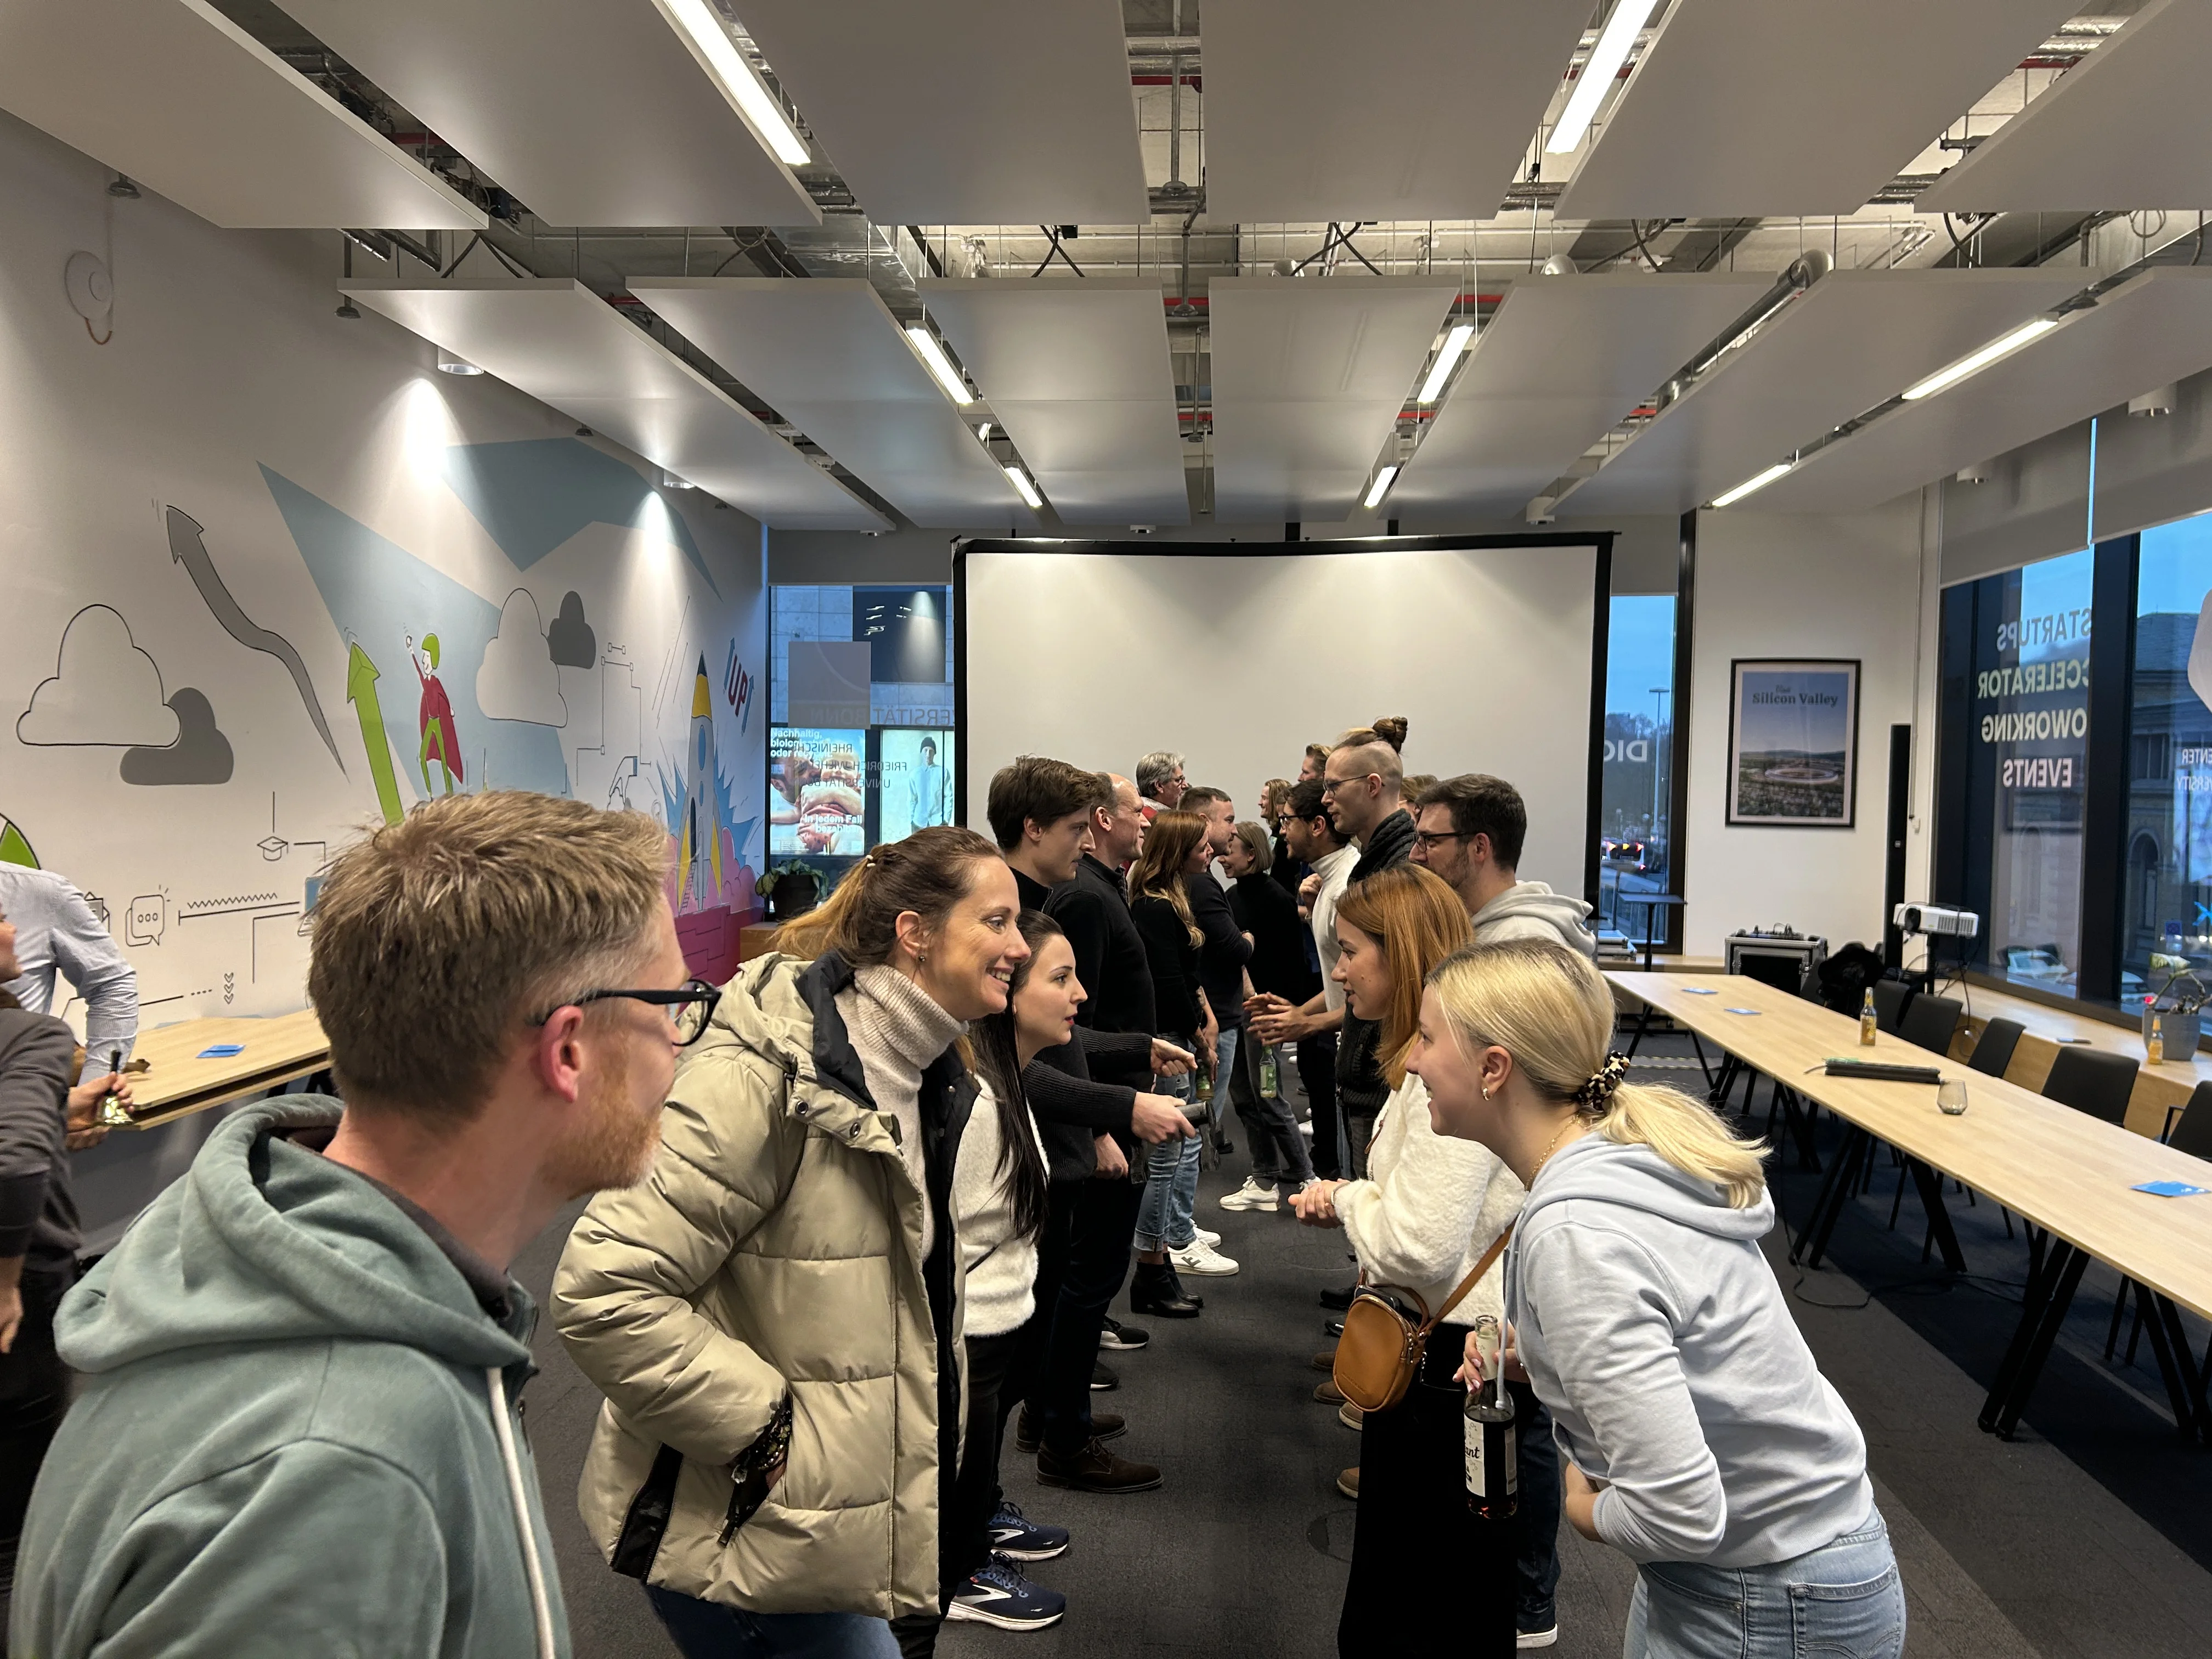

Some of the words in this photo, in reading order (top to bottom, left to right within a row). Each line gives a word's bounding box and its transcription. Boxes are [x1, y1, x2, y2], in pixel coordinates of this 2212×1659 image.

[728, 654, 748, 718] UP
[1752, 692, 1796, 704] Silicon
[1799, 693, 1838, 708] Valley
[770, 748, 792, 757] oder
[794, 749, 833, 760] recylt.
[804, 814, 813, 823] In
[815, 814, 844, 825] jedem
[845, 814, 862, 823] Fall
